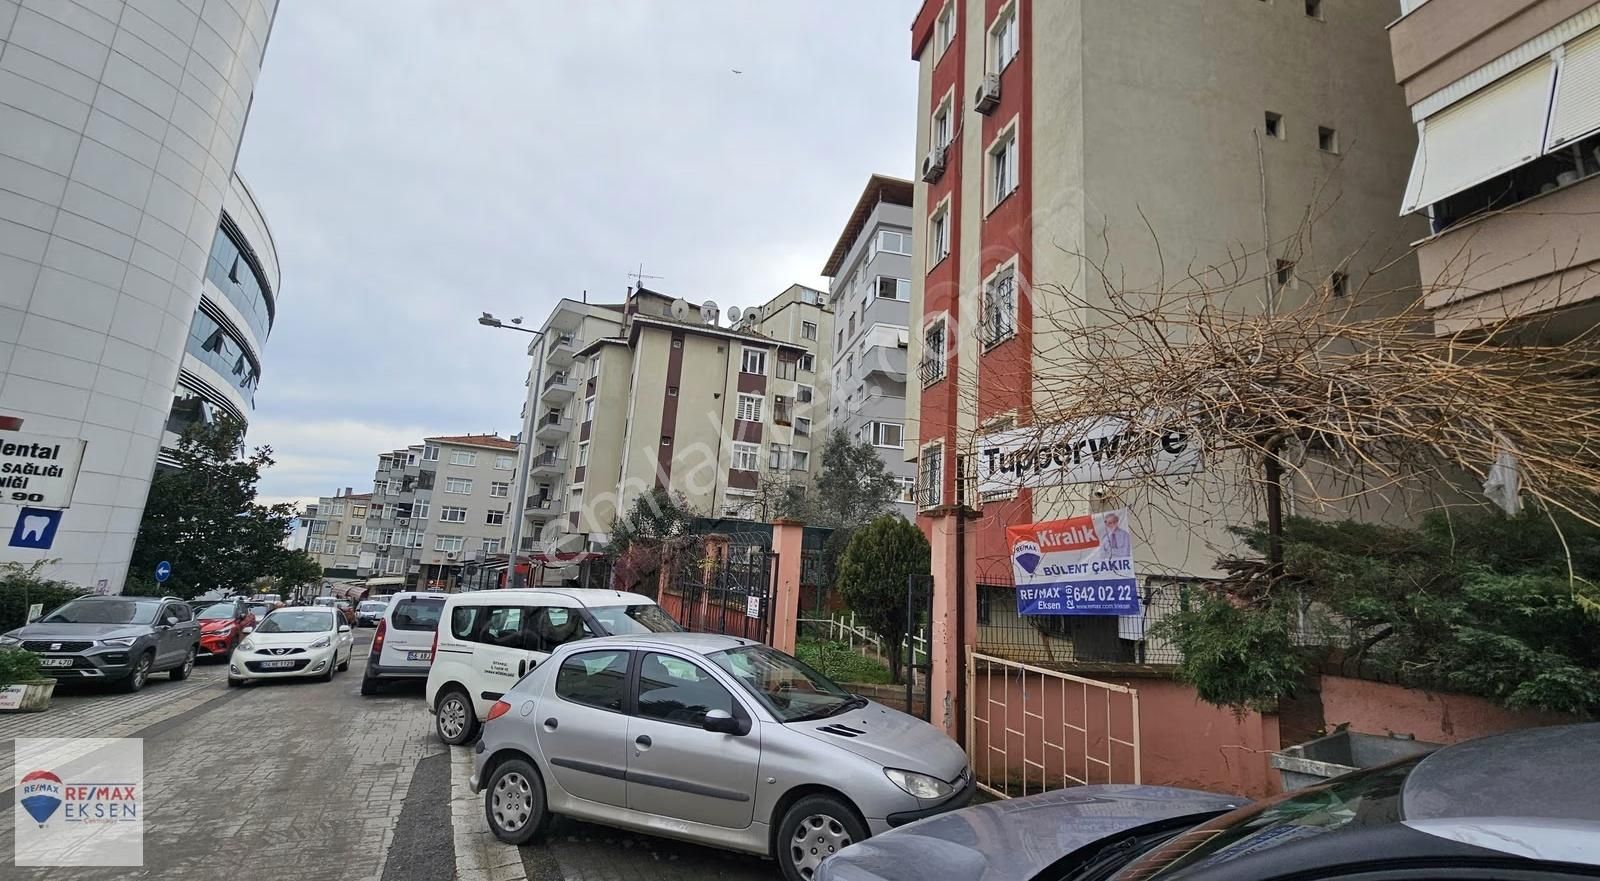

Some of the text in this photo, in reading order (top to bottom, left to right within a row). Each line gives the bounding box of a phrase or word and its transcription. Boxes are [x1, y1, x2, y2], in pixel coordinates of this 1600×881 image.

[1, 462, 64, 478] SAĞLIĞI
[12, 492, 44, 502] 90
[1036, 524, 1098, 548] Kiralık
[1016, 544, 1038, 553] RE/MAX
[1043, 559, 1131, 577] BÜLENT ÇAKIR
[1020, 587, 1060, 600] RE/MAX
[1073, 584, 1132, 602] 642 02 22
[1037, 600, 1061, 610] Eksen
